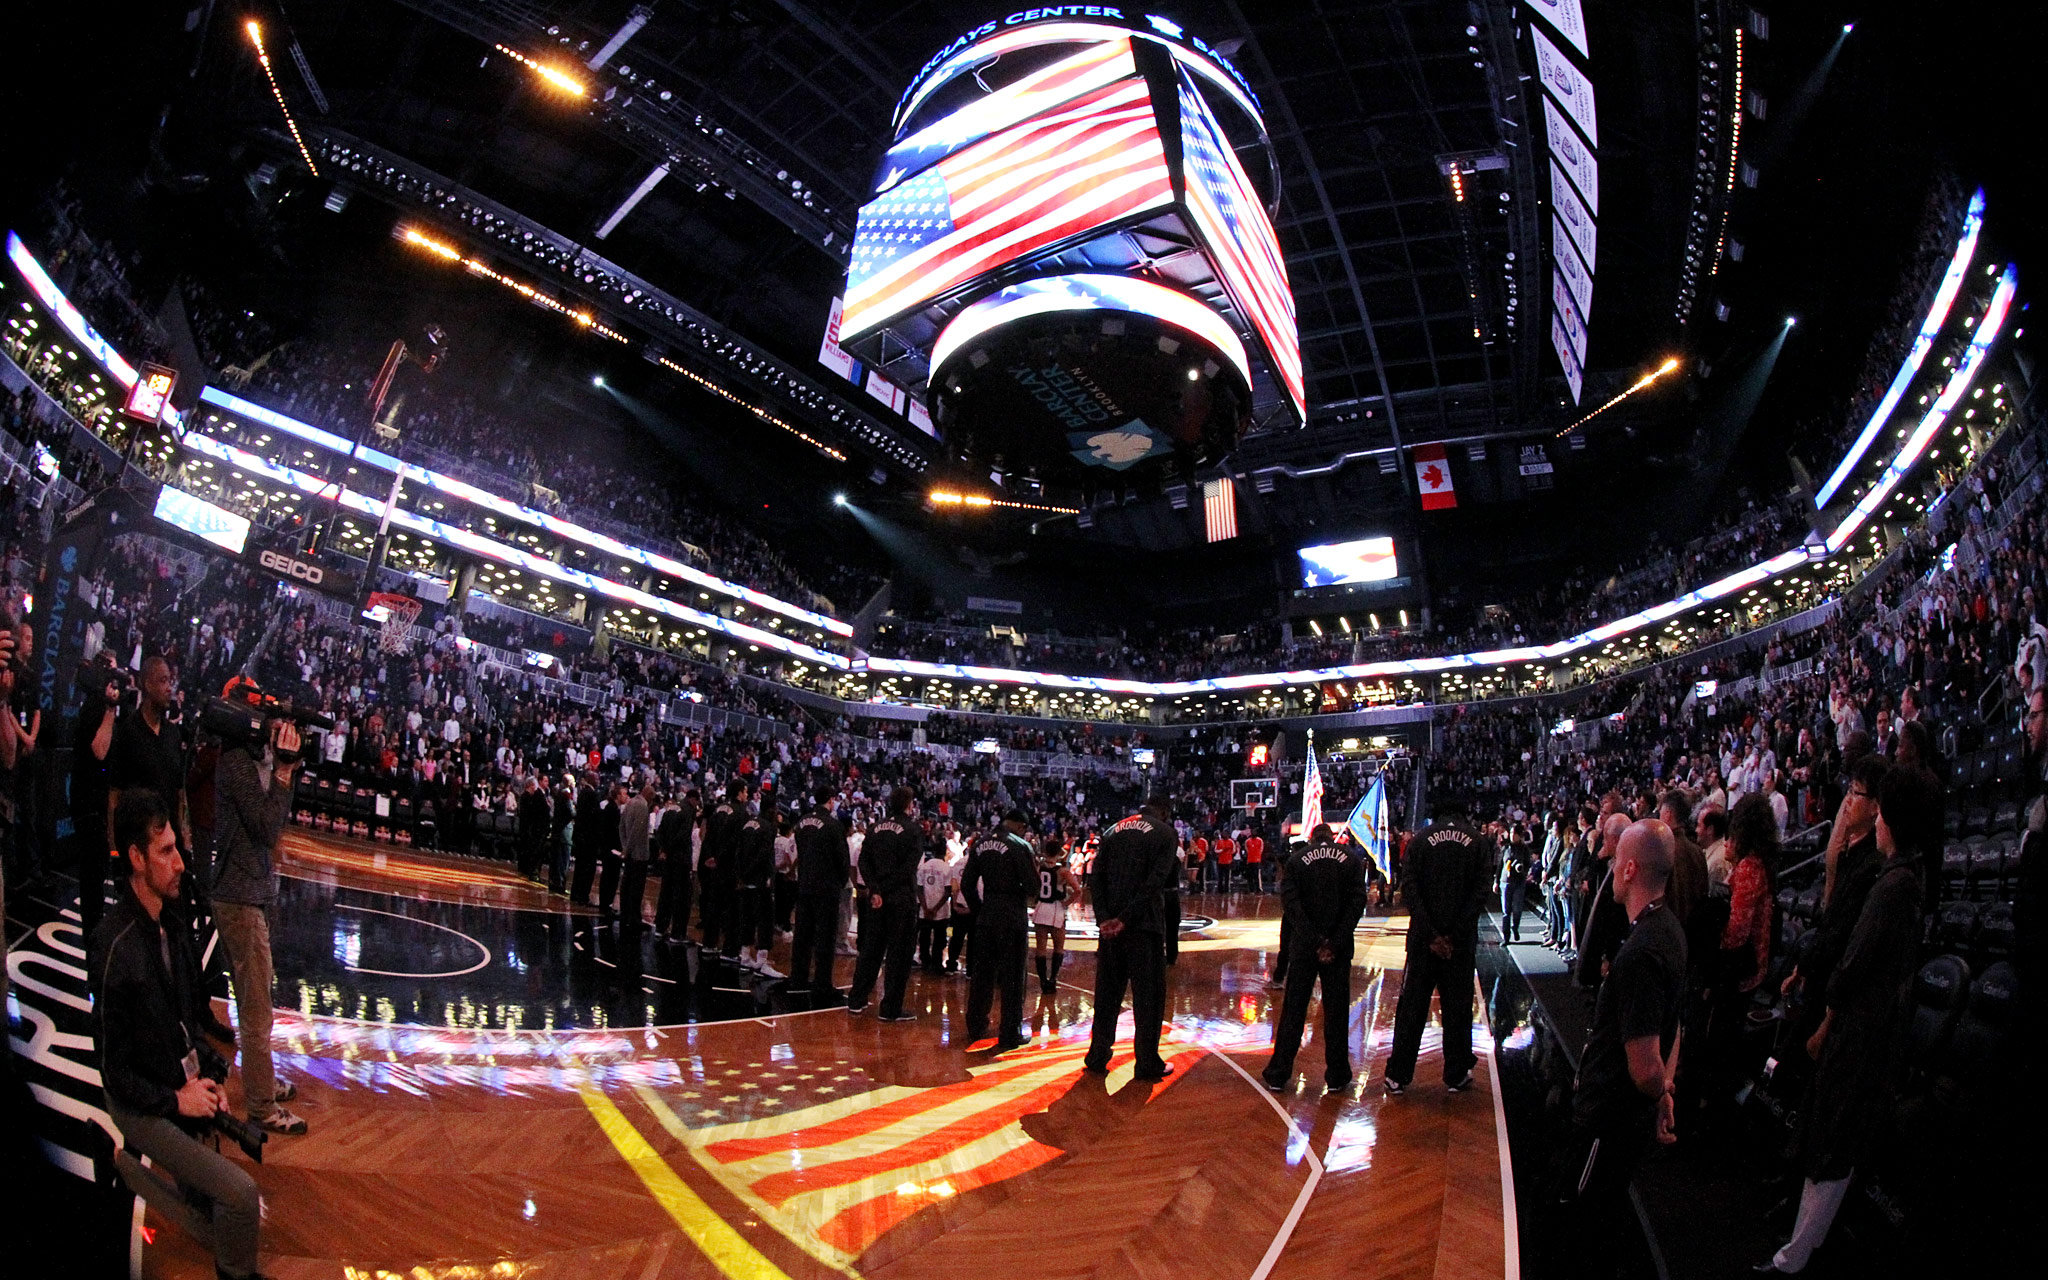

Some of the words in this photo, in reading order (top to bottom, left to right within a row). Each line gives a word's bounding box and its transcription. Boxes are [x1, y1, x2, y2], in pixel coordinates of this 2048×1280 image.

[1005, 5, 1124, 25] CENTER
[825, 343, 850, 364] WILLIAMS
[1008, 362, 1088, 428] BARCLAY
[1041, 362, 1109, 422] CENTER
[1071, 367, 1124, 416] BROOKLYN
[1520, 445, 1535, 457] JAY
[1537, 444, 1546, 456] Z
[260, 550, 324, 585] GEICO
[39, 577, 71, 710] BARCLAYS
[874, 821, 905, 835] BROOKLYN
[1114, 819, 1154, 835] BROOKLYN
[975, 839, 1009, 857] BROOKLYN
[1427, 830, 1473, 847] BROOKLYN
[1301, 847, 1348, 866] BROOKLYN
